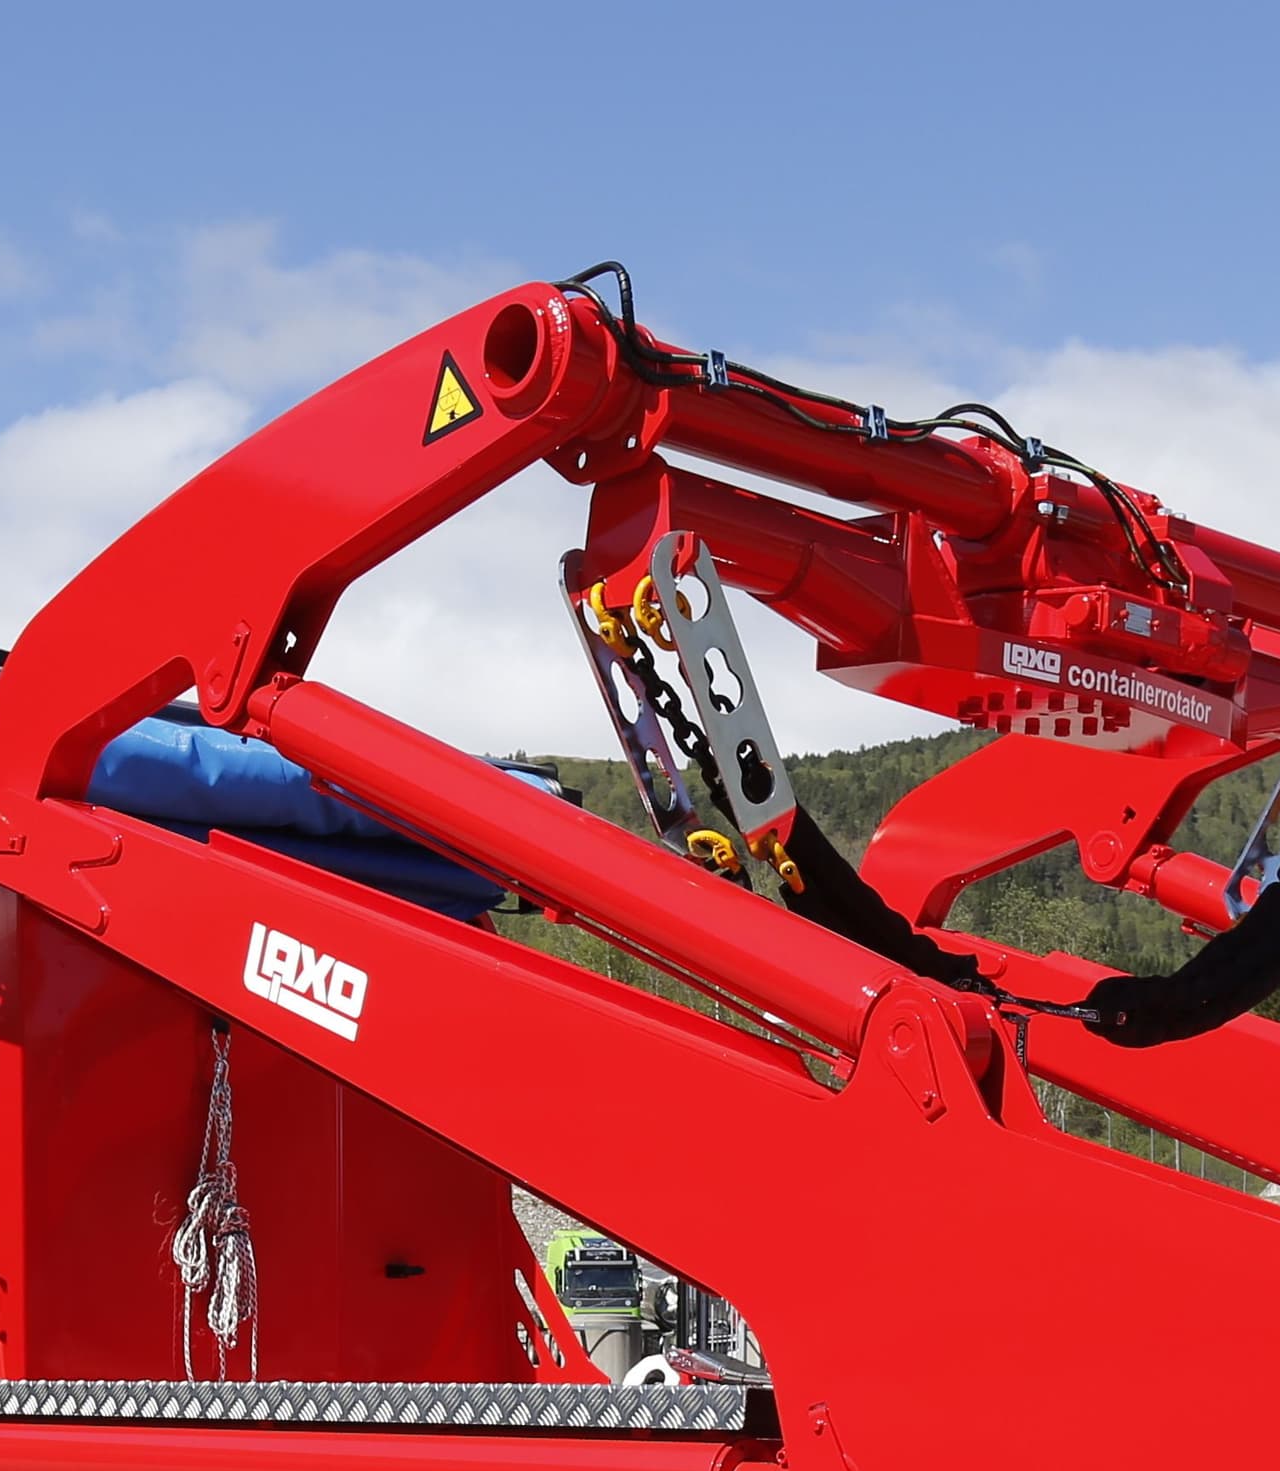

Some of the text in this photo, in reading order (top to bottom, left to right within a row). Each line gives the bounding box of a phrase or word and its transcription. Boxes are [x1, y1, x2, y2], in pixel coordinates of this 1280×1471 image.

[1003, 642, 1212, 725] LAXO containerrotator
[243, 920, 369, 1043] LAXO
